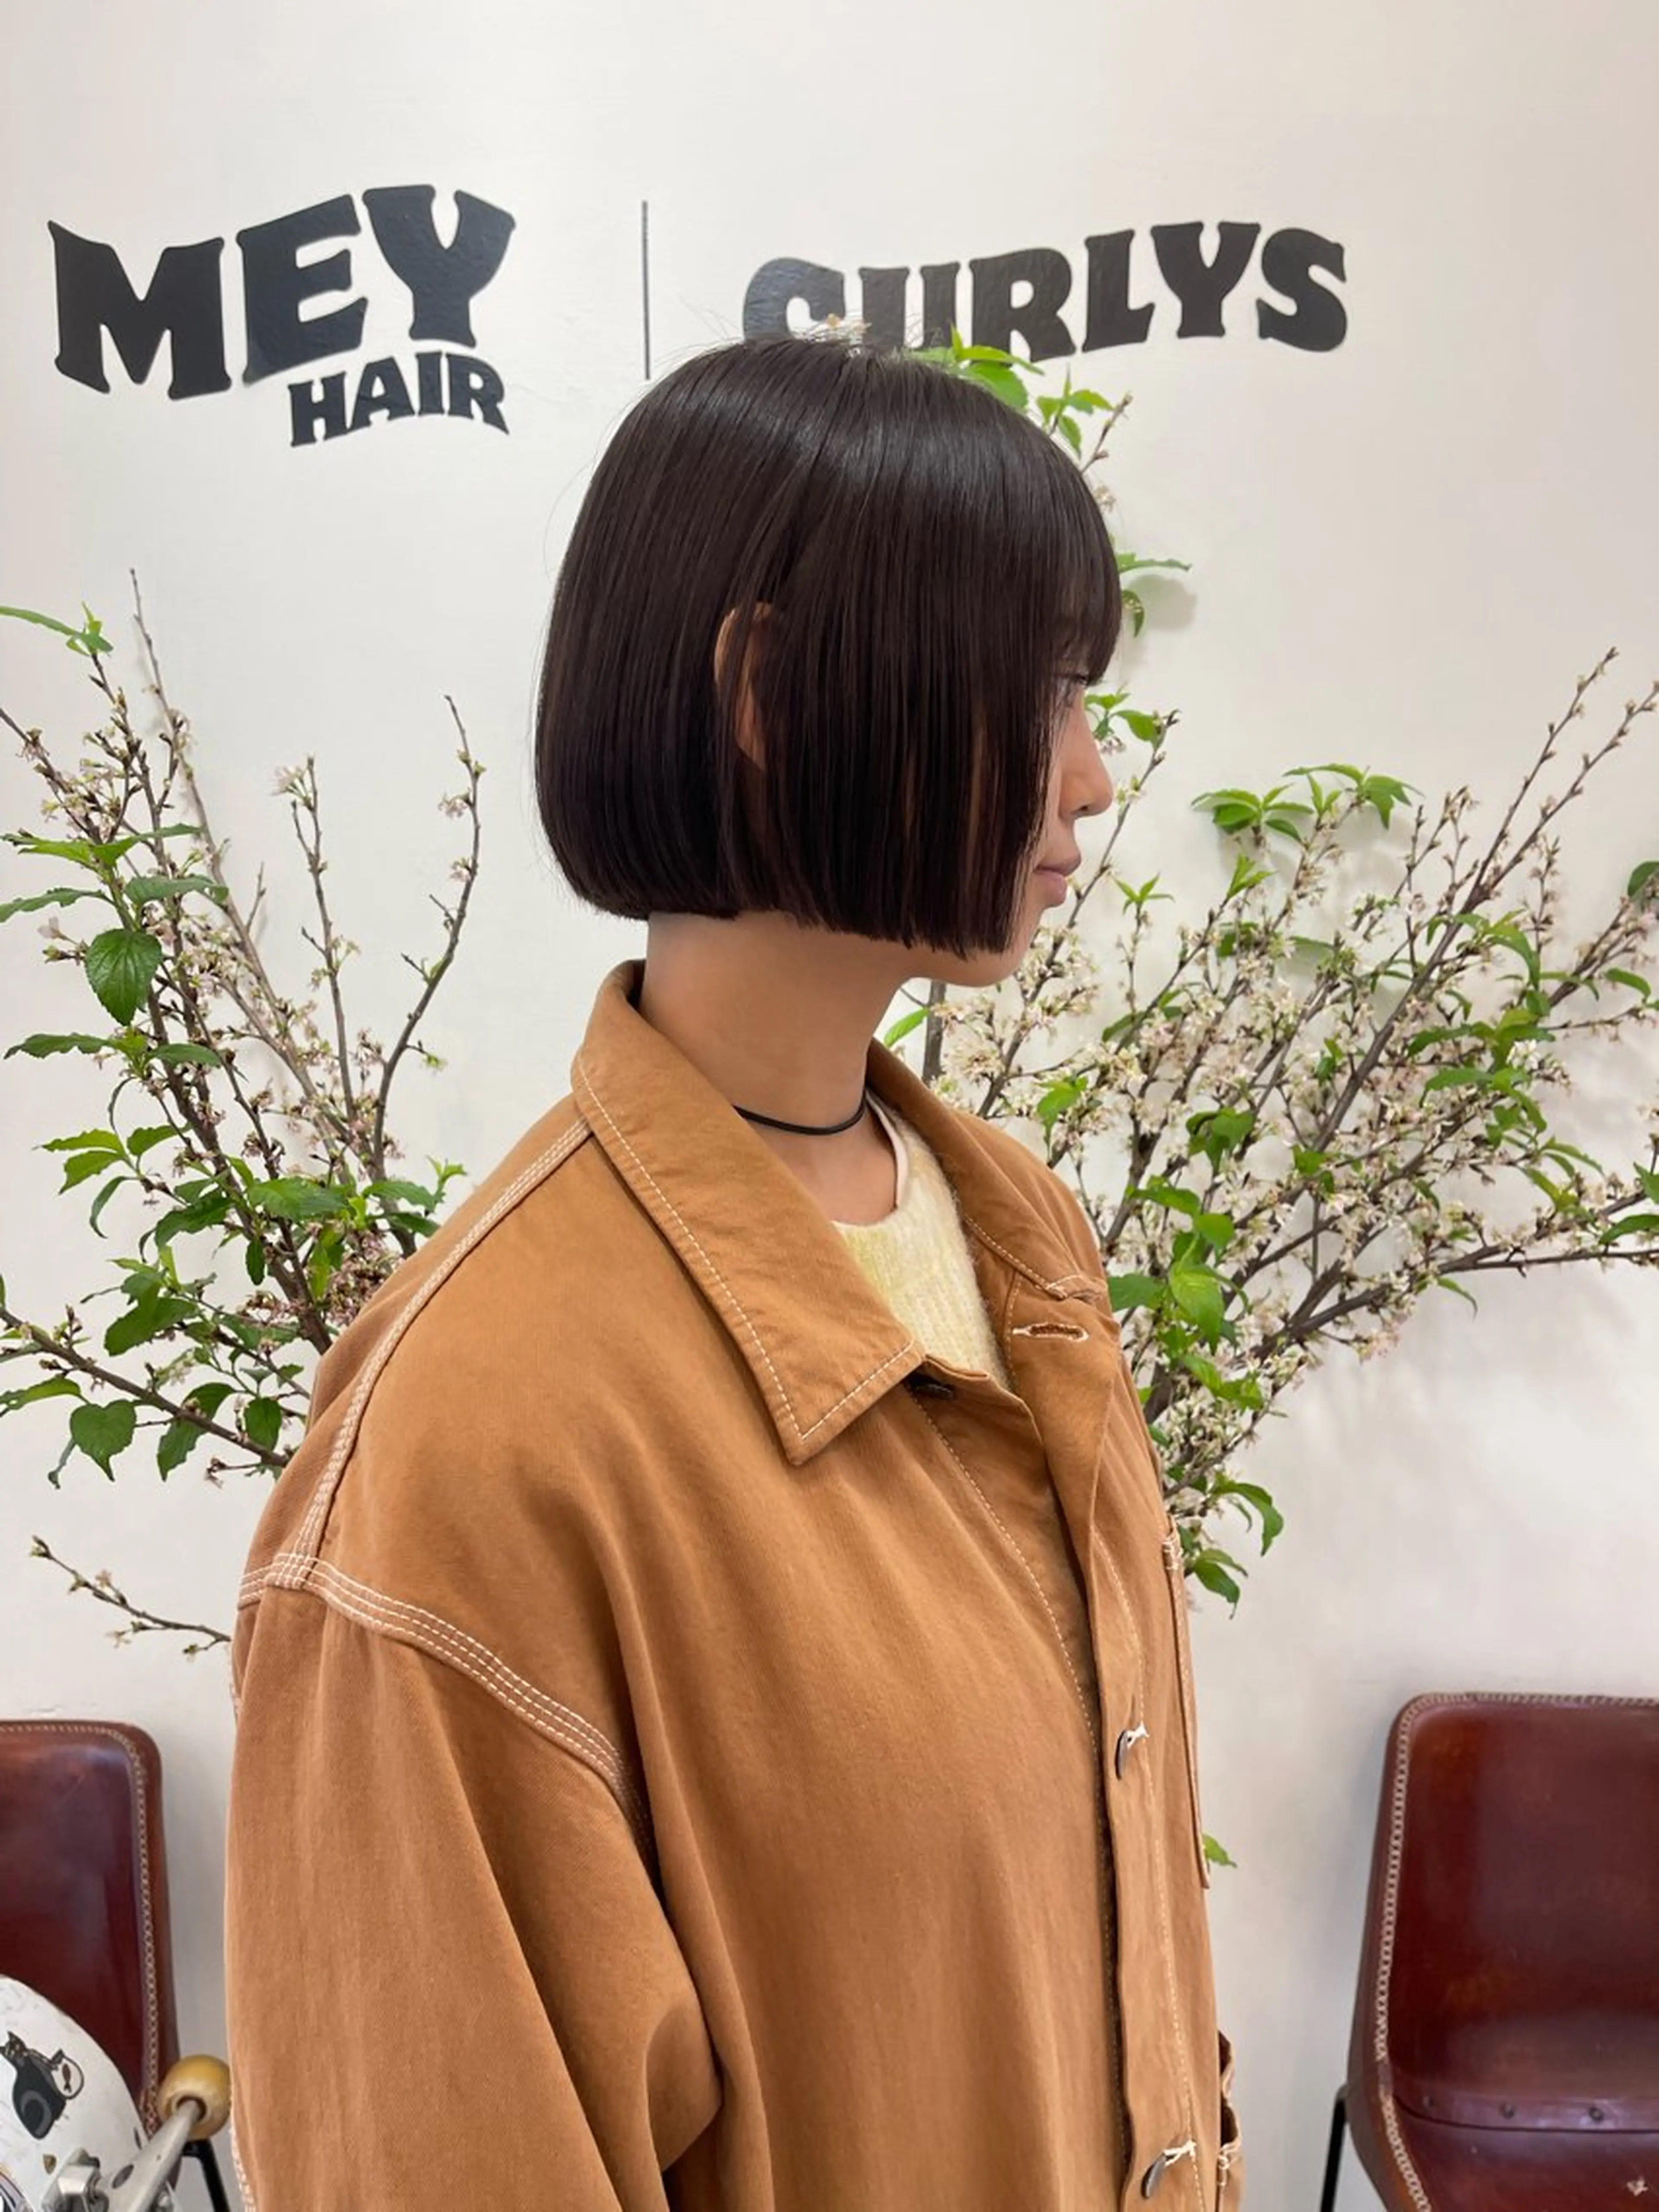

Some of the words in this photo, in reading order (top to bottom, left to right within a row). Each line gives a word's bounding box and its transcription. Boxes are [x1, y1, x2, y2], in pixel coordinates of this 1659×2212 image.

[47, 184, 515, 400] MEY
[742, 221, 1348, 365] CURLYS
[287, 351, 509, 447] HAIR
